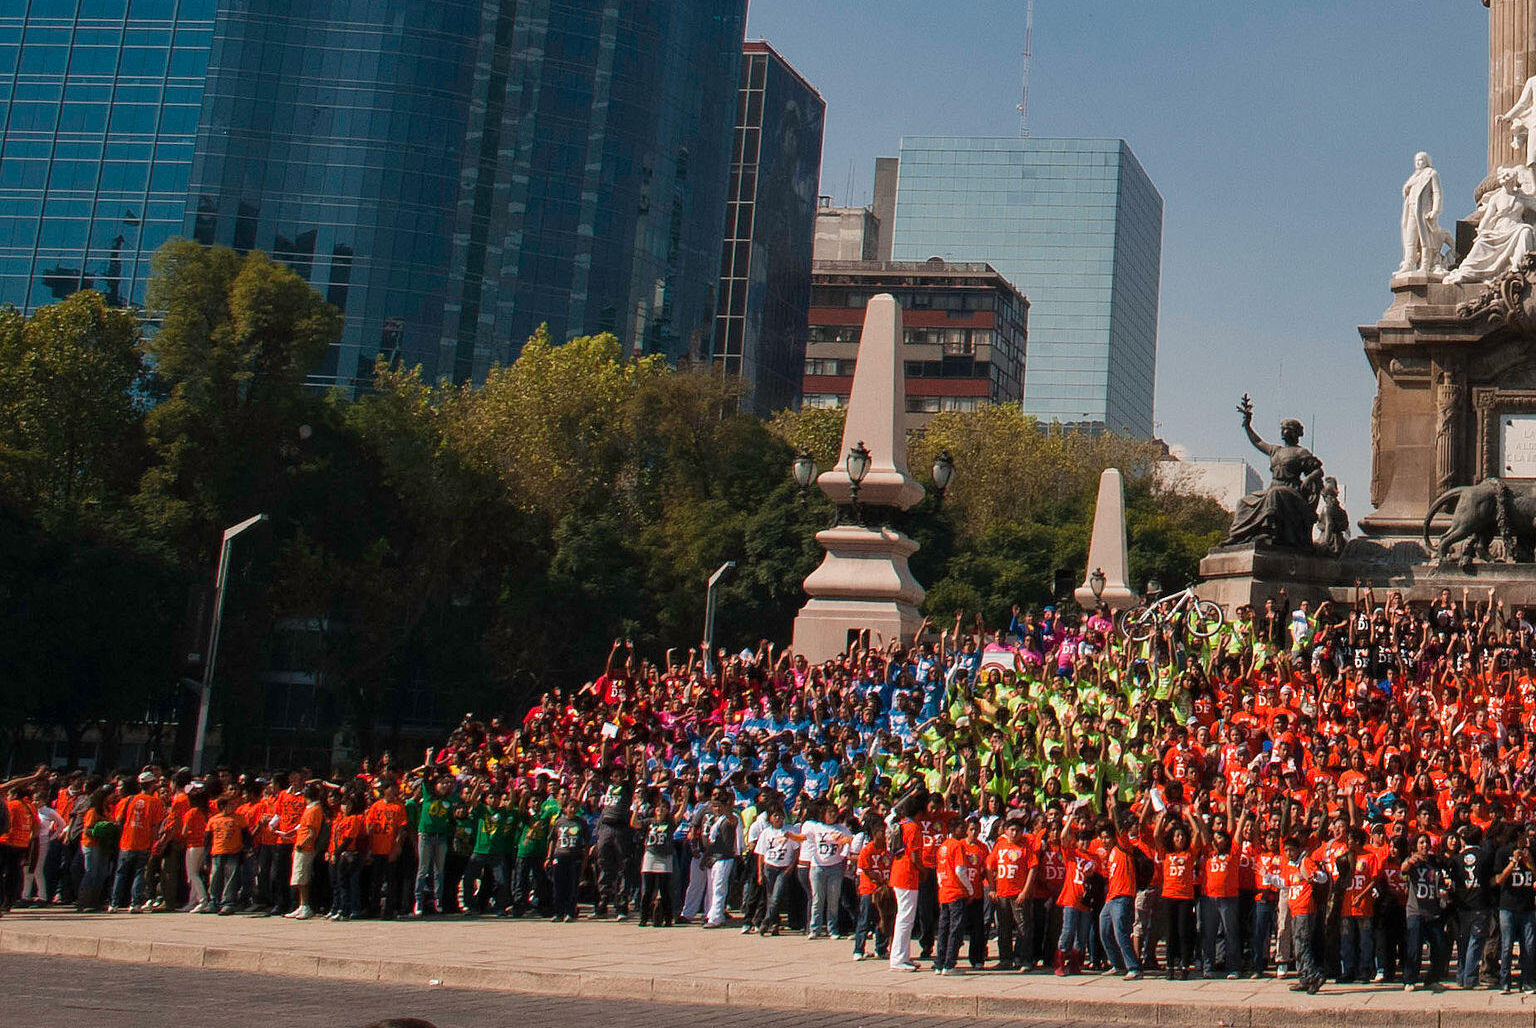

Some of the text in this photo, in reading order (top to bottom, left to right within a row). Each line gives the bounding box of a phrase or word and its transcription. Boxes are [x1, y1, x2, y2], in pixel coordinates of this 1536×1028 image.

[1378, 654, 1394, 663] DF
[1194, 704, 1212, 714] DF
[921, 820, 932, 833] Y
[560, 836, 577, 848] DF
[648, 834, 668, 845] DF
[767, 850, 787, 860] DF
[820, 843, 838, 855] DF
[872, 854, 880, 868] Y
[998, 848, 1008, 864] Y
[1046, 852, 1056, 865] Y
[1169, 856, 1176, 866] Y
[997, 864, 1018, 879] DF
[1170, 866, 1186, 876] DF
[1211, 862, 1228, 872] DF
[1417, 868, 1428, 882] Y
[1512, 872, 1532, 886] DF
